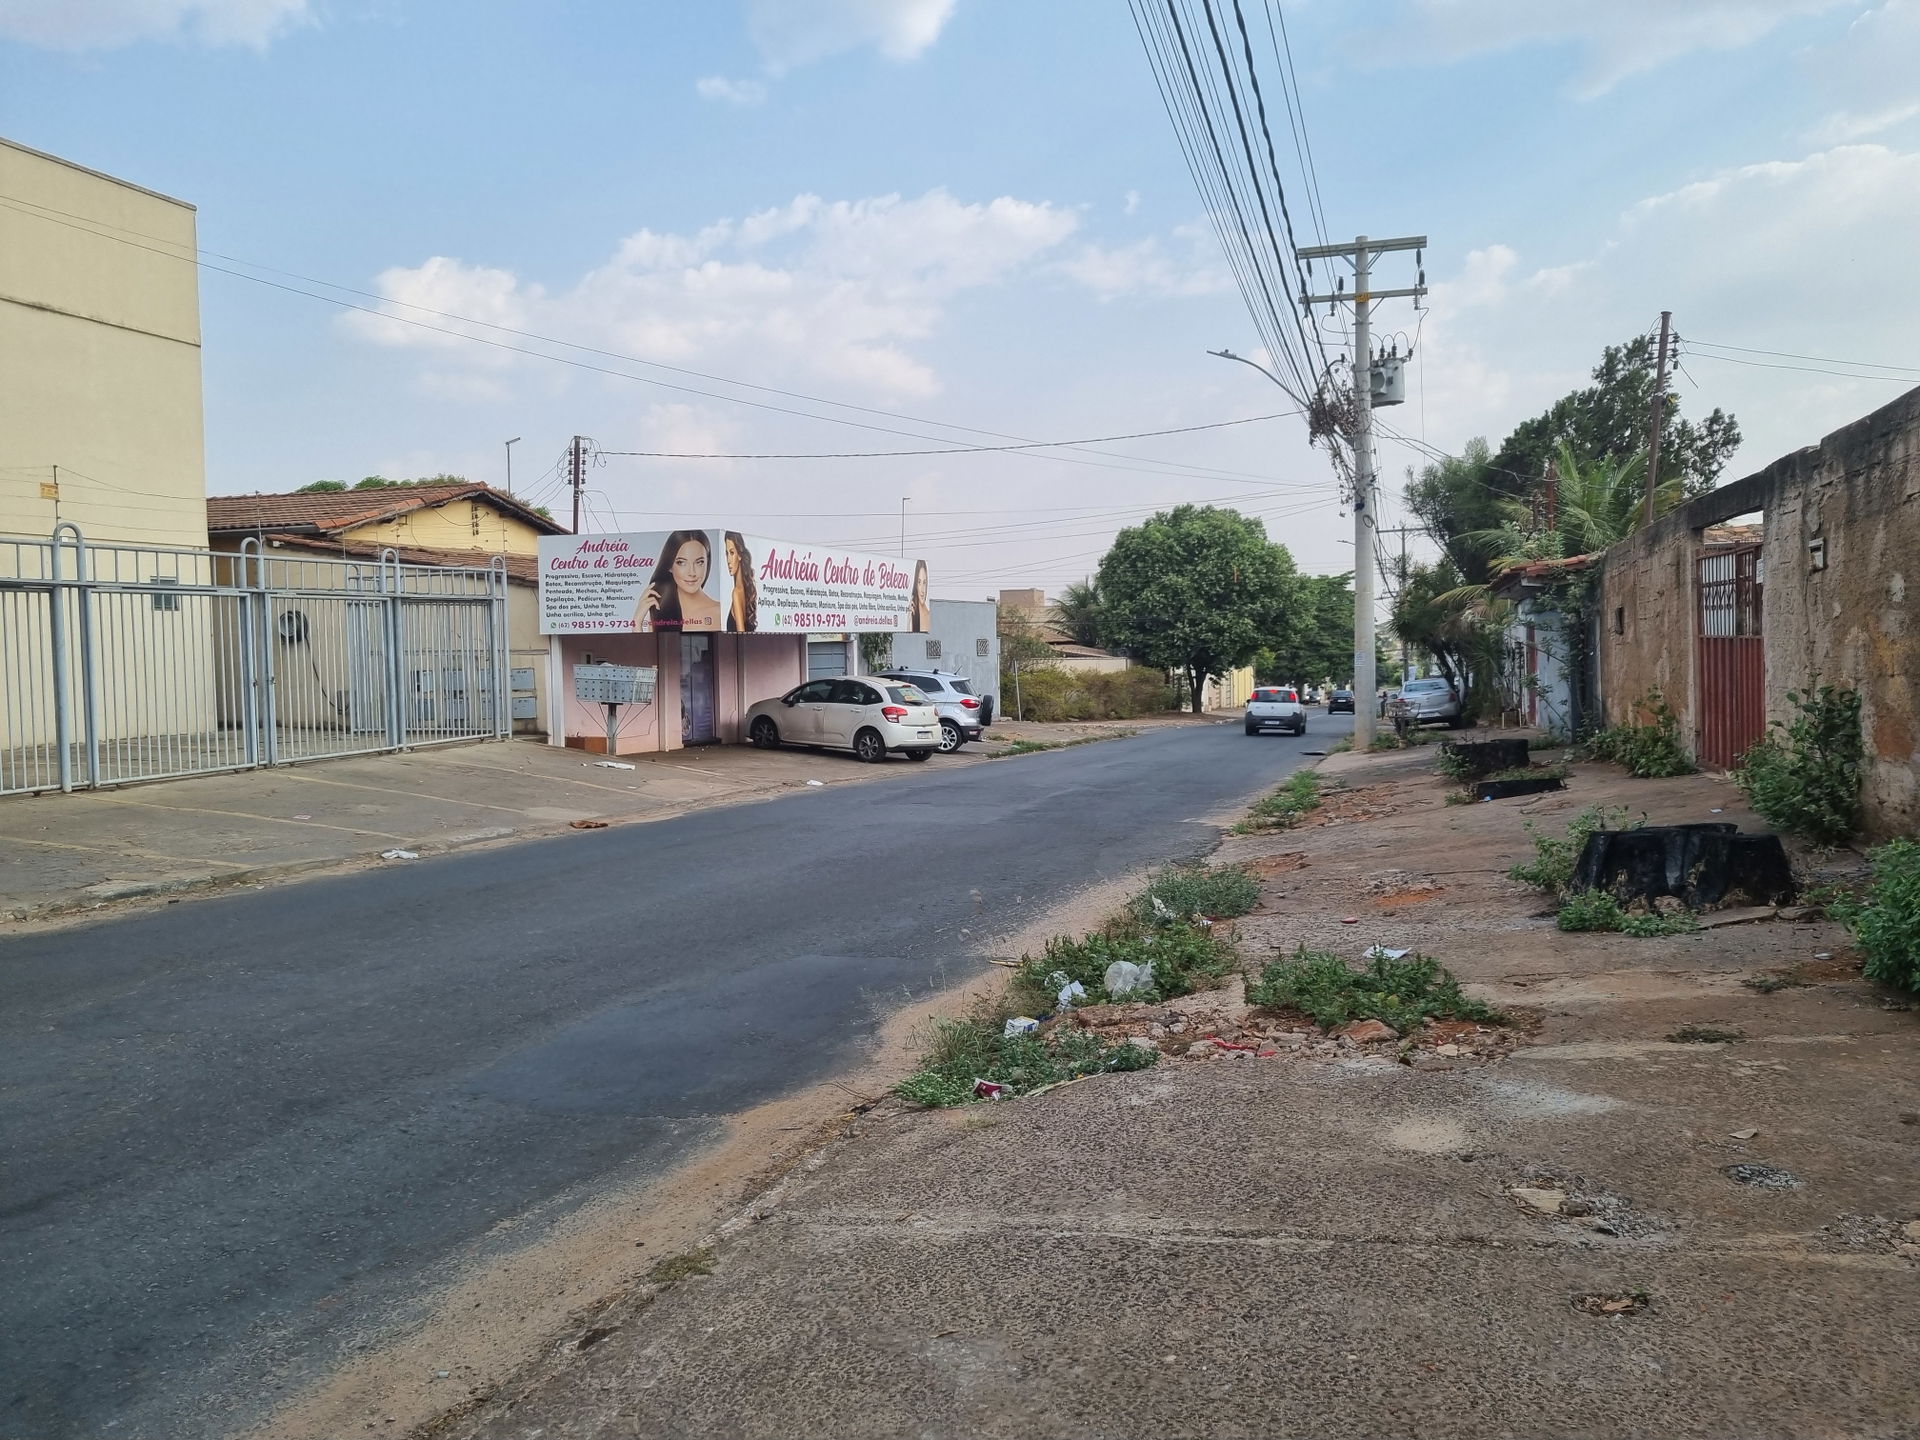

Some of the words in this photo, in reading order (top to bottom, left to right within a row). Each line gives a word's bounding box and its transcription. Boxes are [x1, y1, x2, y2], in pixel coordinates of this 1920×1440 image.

[575, 538, 630, 555] Andréia
[551, 555, 589, 571] Centro
[594, 554, 609, 569] de
[613, 553, 655, 570] Beleza
[759, 548, 820, 583] Andréia
[823, 556, 860, 586] Centro
[863, 560, 876, 587] de
[878, 562, 910, 590] Beleza
[545, 573, 580, 581] Progressiva,
[581, 572, 603, 580] Escova,
[604, 572, 639, 580] Hidratação,
[564, 580, 604, 588] Reconstrução,
[605, 579, 642, 587] Maquiagem,
[600, 587, 625, 595] Aplique,
[606, 594, 636, 602] Manicure,
[583, 602, 600, 610] Unha
[546, 611, 562, 619] Unha
[571, 619, 637, 630] 98519-9734
[782, 614, 792, 627] (62)
[793, 612, 846, 628] 98519-9734
